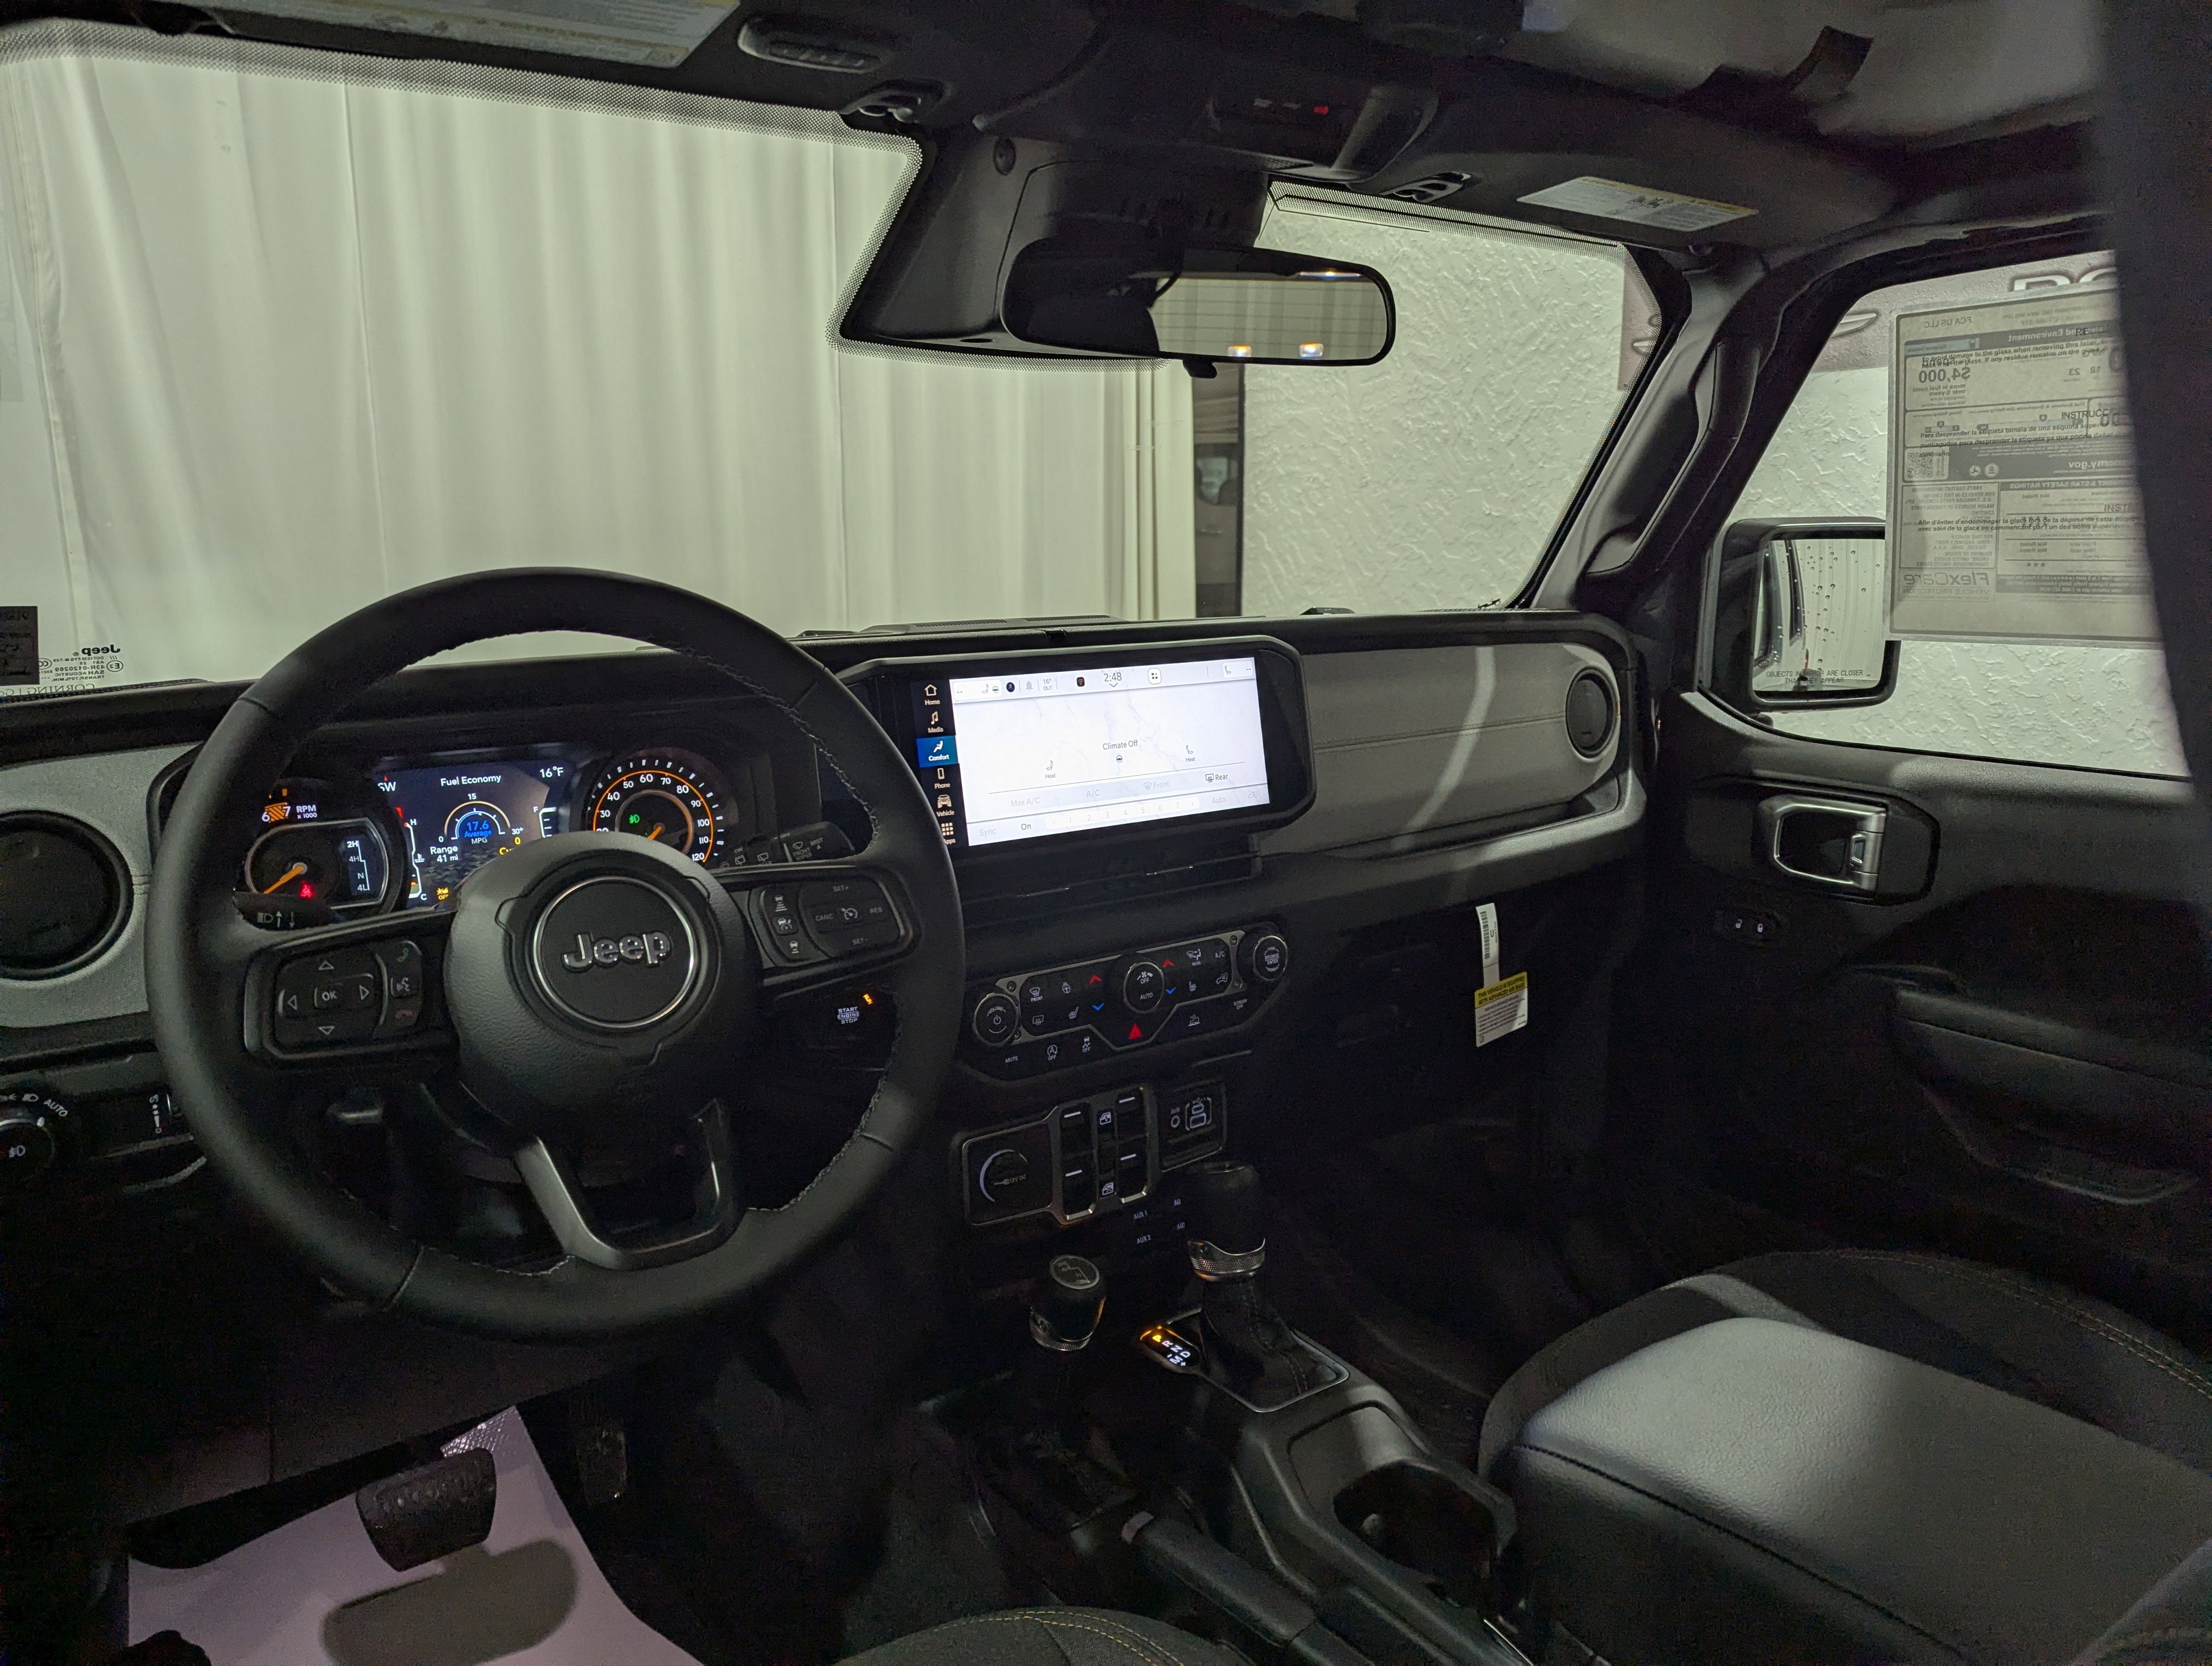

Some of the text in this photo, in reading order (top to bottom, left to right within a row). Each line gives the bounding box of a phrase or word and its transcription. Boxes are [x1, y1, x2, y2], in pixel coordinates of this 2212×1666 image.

[1103, 671, 1122, 683] 2:48
[1102, 739, 1138, 750] Climate Off
[539, 766, 563, 778] 16°F
[440, 774, 501, 786] Fuel Economy
[639, 773, 653, 783] 60
[660, 777, 671, 785] 70
[378, 781, 396, 792] SW
[623, 781, 634, 789] 50
[1153, 780, 1170, 789] Front
[676, 785, 689, 794] 80
[607, 791, 620, 802] 40
[1026, 797, 1041, 805] A/C
[282, 805, 291, 817] 7
[296, 804, 316, 813] RPM
[262, 812, 270, 822] 6
[600, 809, 611, 818] 30
[466, 820, 489, 831] 17.6
[697, 818, 710, 828] 100
[464, 829, 492, 838] Average
[511, 827, 524, 835] 30+
[979, 829, 996, 837] Sync
[347, 840, 358, 848] 2H
[515, 837, 521, 845] 0
[698, 836, 709, 844] 110
[809, 837, 824, 846] MIST
[430, 846, 458, 855] Range
[437, 855, 447, 863] 41
[691, 852, 705, 861] 120
[562, 931, 670, 971] Jeep
[1214, 951, 1225, 959] A/C
[321, 989, 338, 1001] OK
[863, 994, 873, 1005] RUN
[1140, 992, 1153, 1000] AUTO
[837, 1011, 860, 1019] ENGINE
[987, 1005, 1006, 1016] VOLUME
[43, 1099, 69, 1117] AUTO
[1171, 1345, 1183, 1353] N
[1169, 1355, 1183, 1364] M
